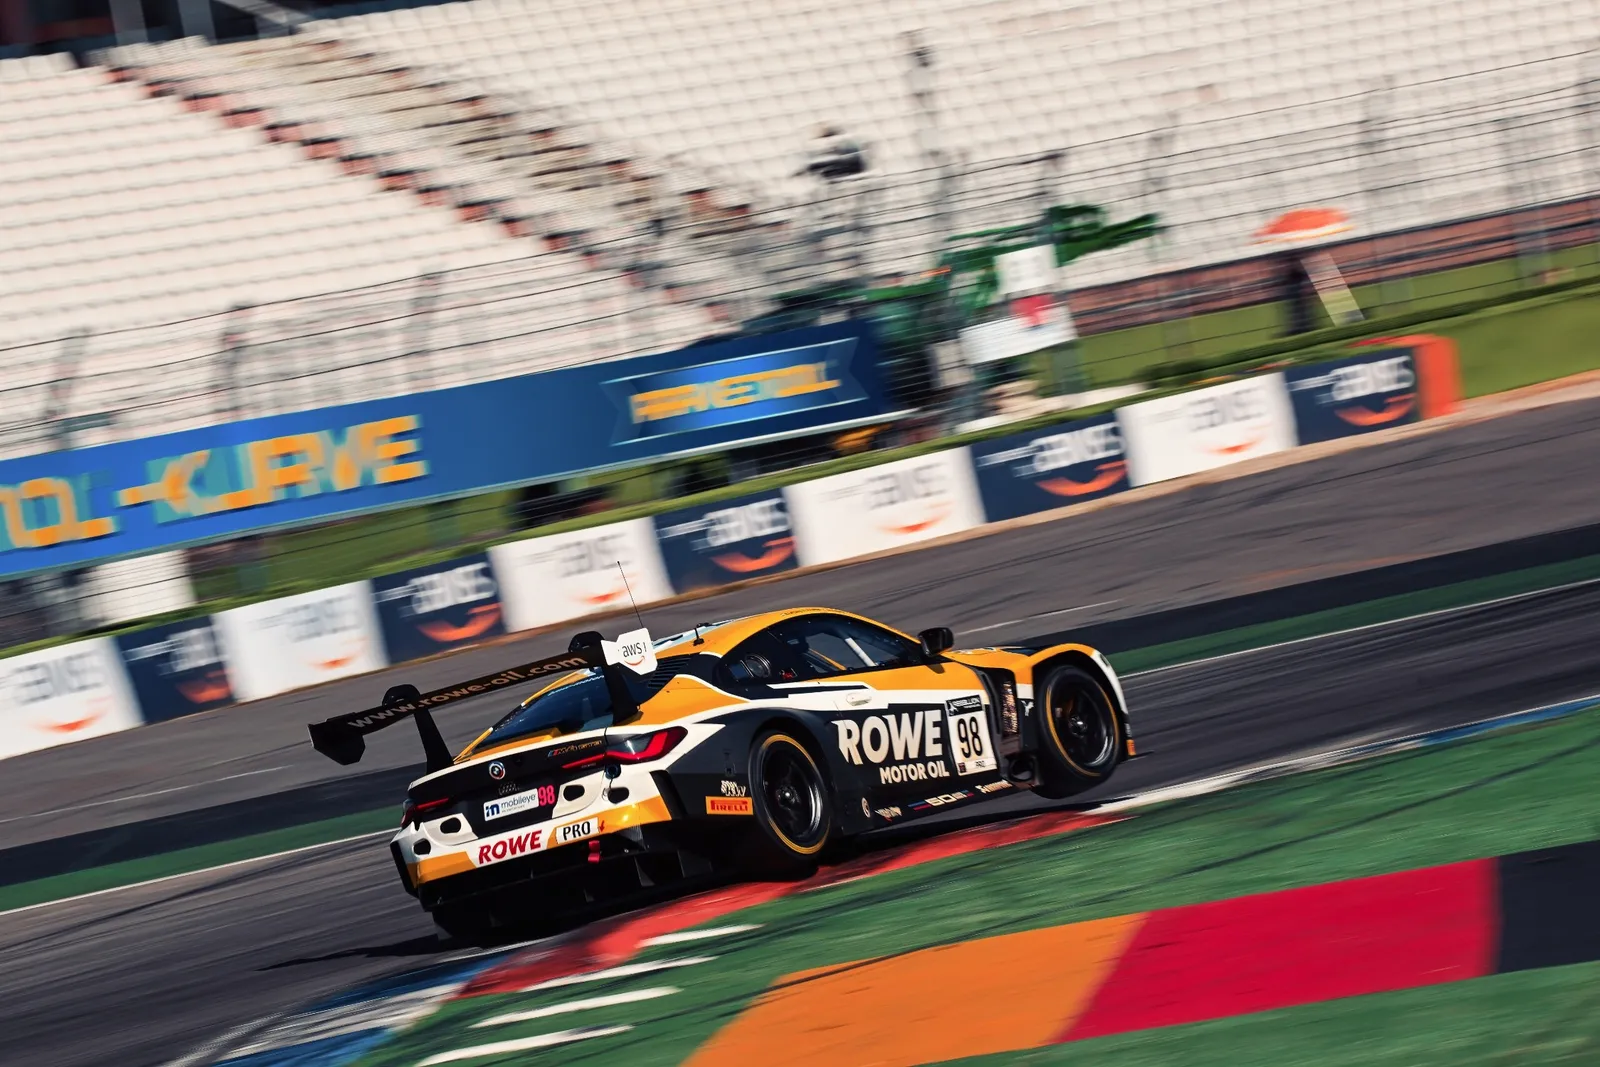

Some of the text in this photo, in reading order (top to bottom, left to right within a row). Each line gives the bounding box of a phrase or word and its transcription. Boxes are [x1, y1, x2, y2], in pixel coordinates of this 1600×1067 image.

[621, 642, 643, 658] aws
[348, 655, 588, 730] www.rowe-oil.com
[831, 709, 943, 765] ROWE
[957, 716, 983, 758] 98
[879, 760, 950, 785] MOTOR OIL
[501, 793, 536, 809] mobileye
[538, 784, 555, 806] 98
[710, 799, 748, 812] PIRELLI
[562, 821, 591, 841] PRO
[478, 829, 542, 864] ROWE
